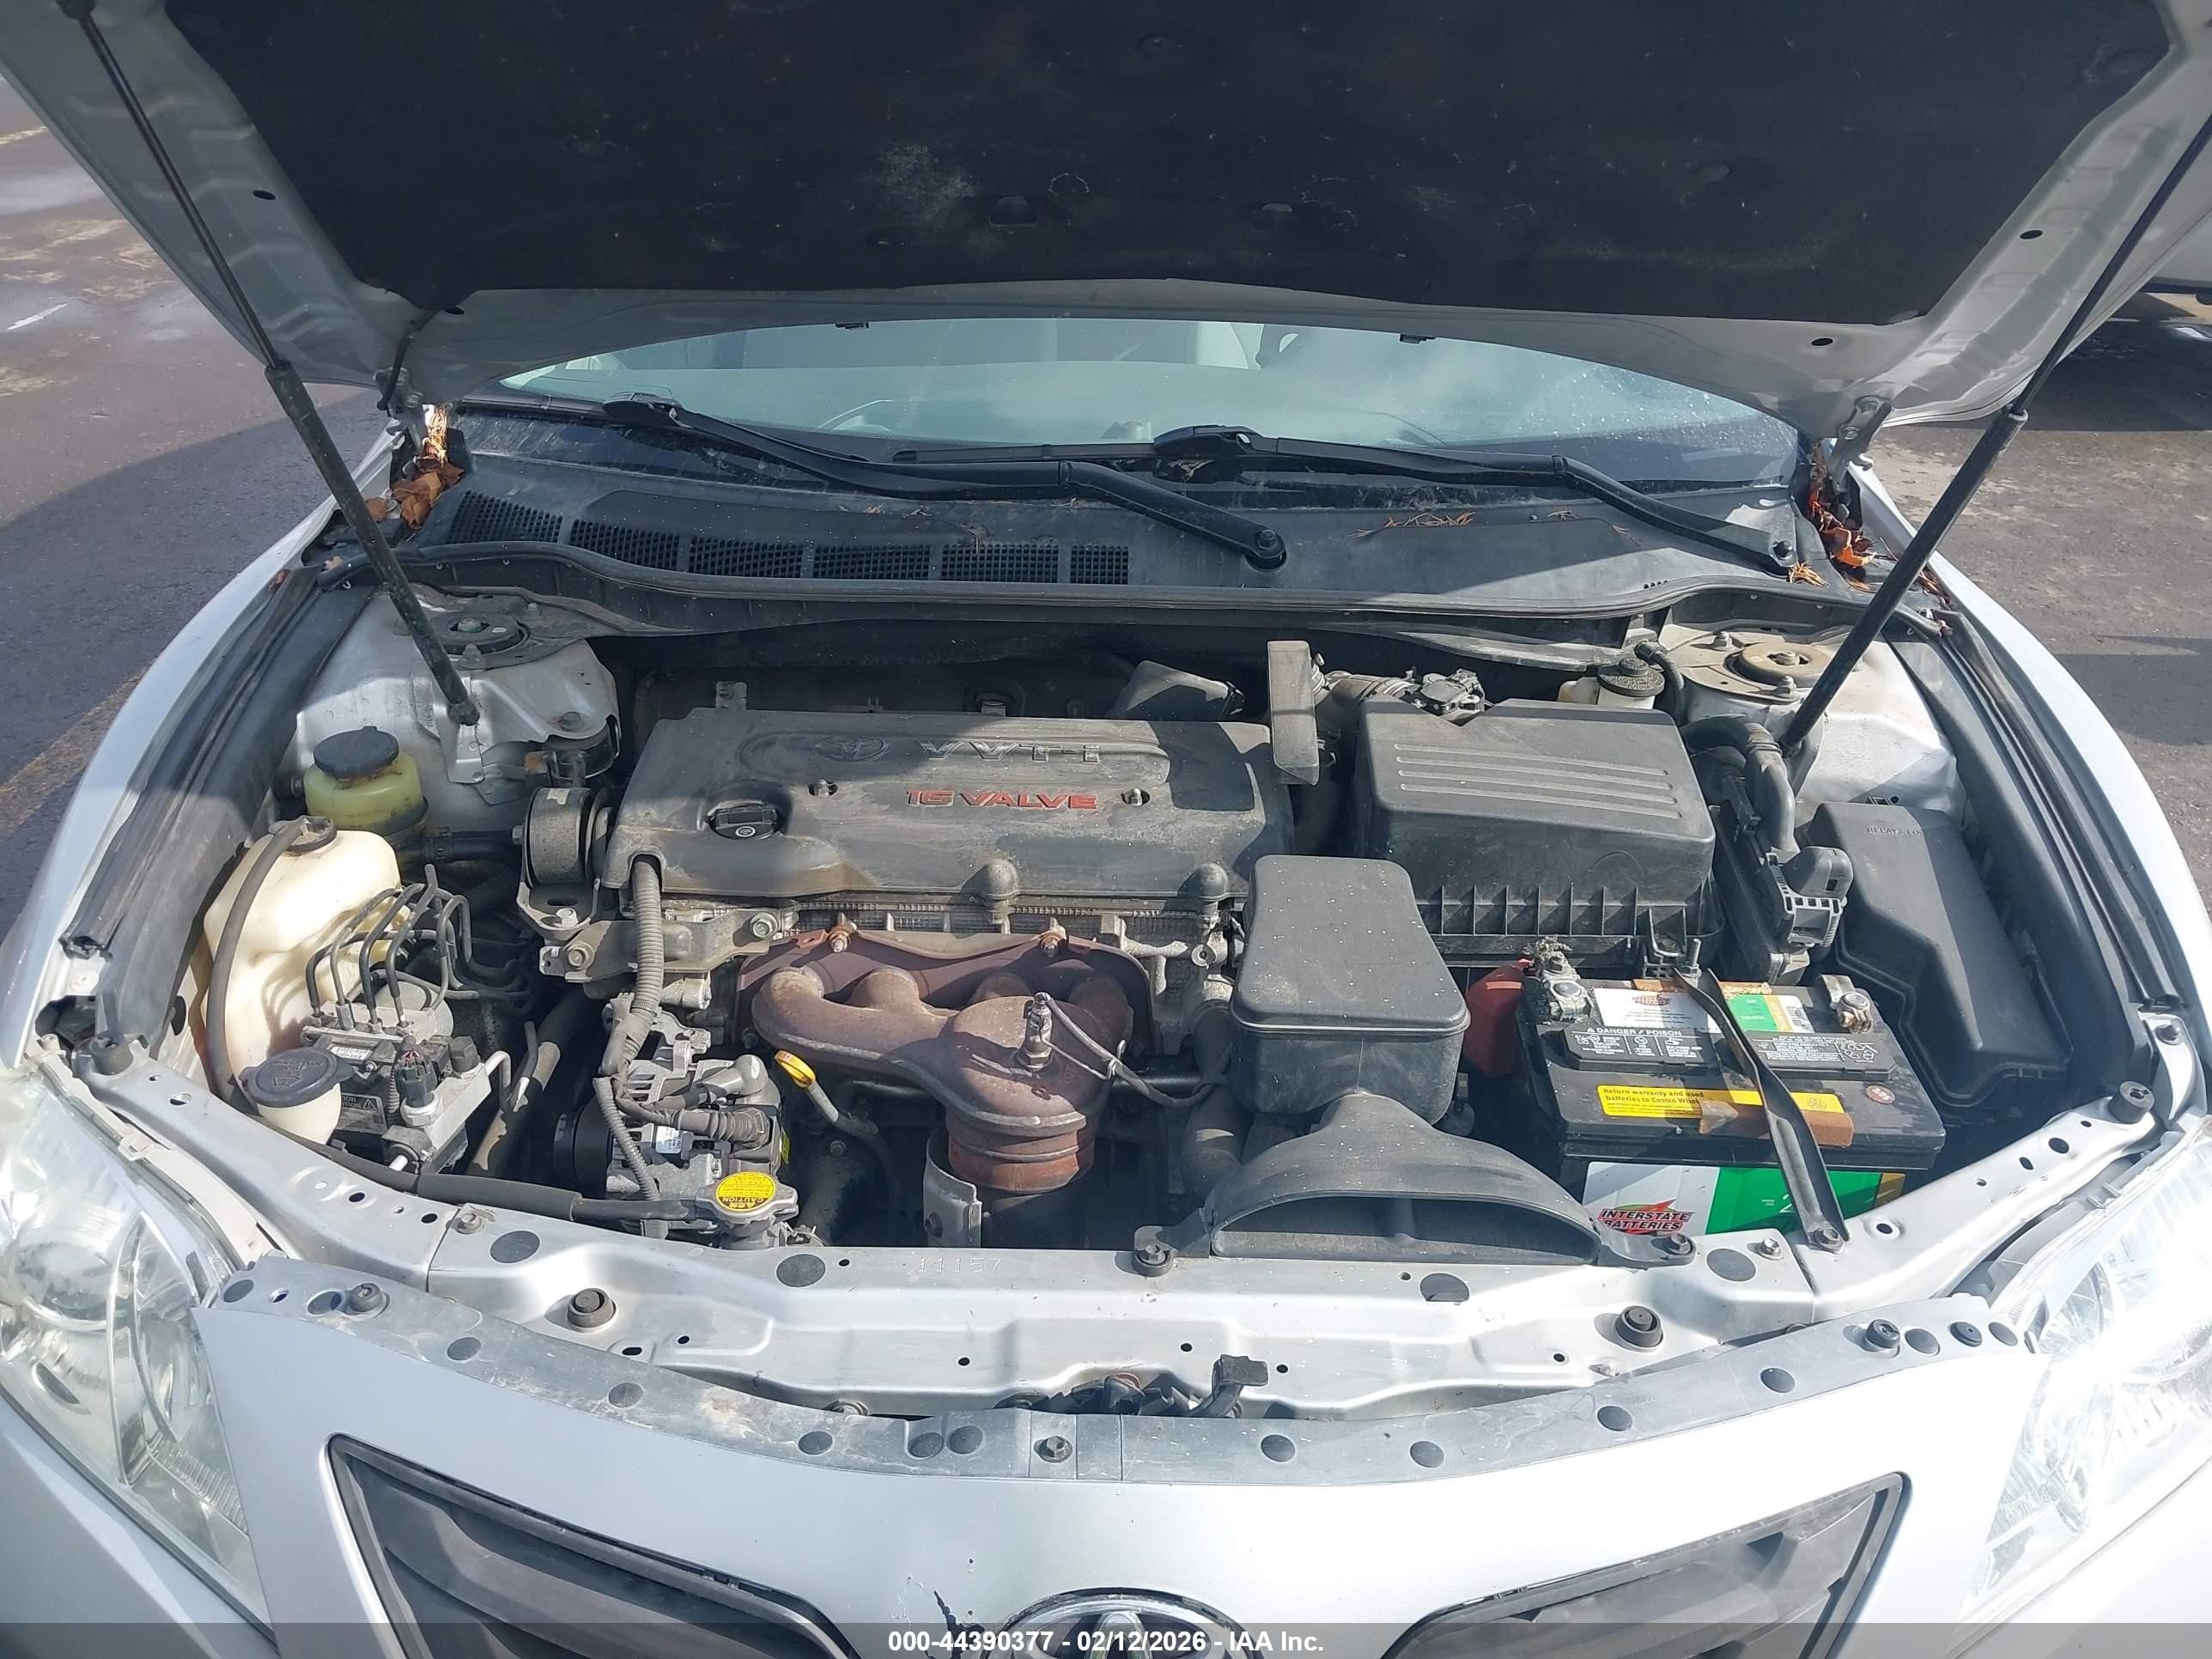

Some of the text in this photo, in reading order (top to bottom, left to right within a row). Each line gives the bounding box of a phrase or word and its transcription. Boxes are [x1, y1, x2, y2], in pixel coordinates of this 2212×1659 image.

[908, 789, 1098, 811] 16 VALVE
[1605, 1094, 1641, 1103] batteries
[1601, 1209, 1691, 1221] INTERSTATE
[1604, 1219, 1682, 1230] BATTERIES
